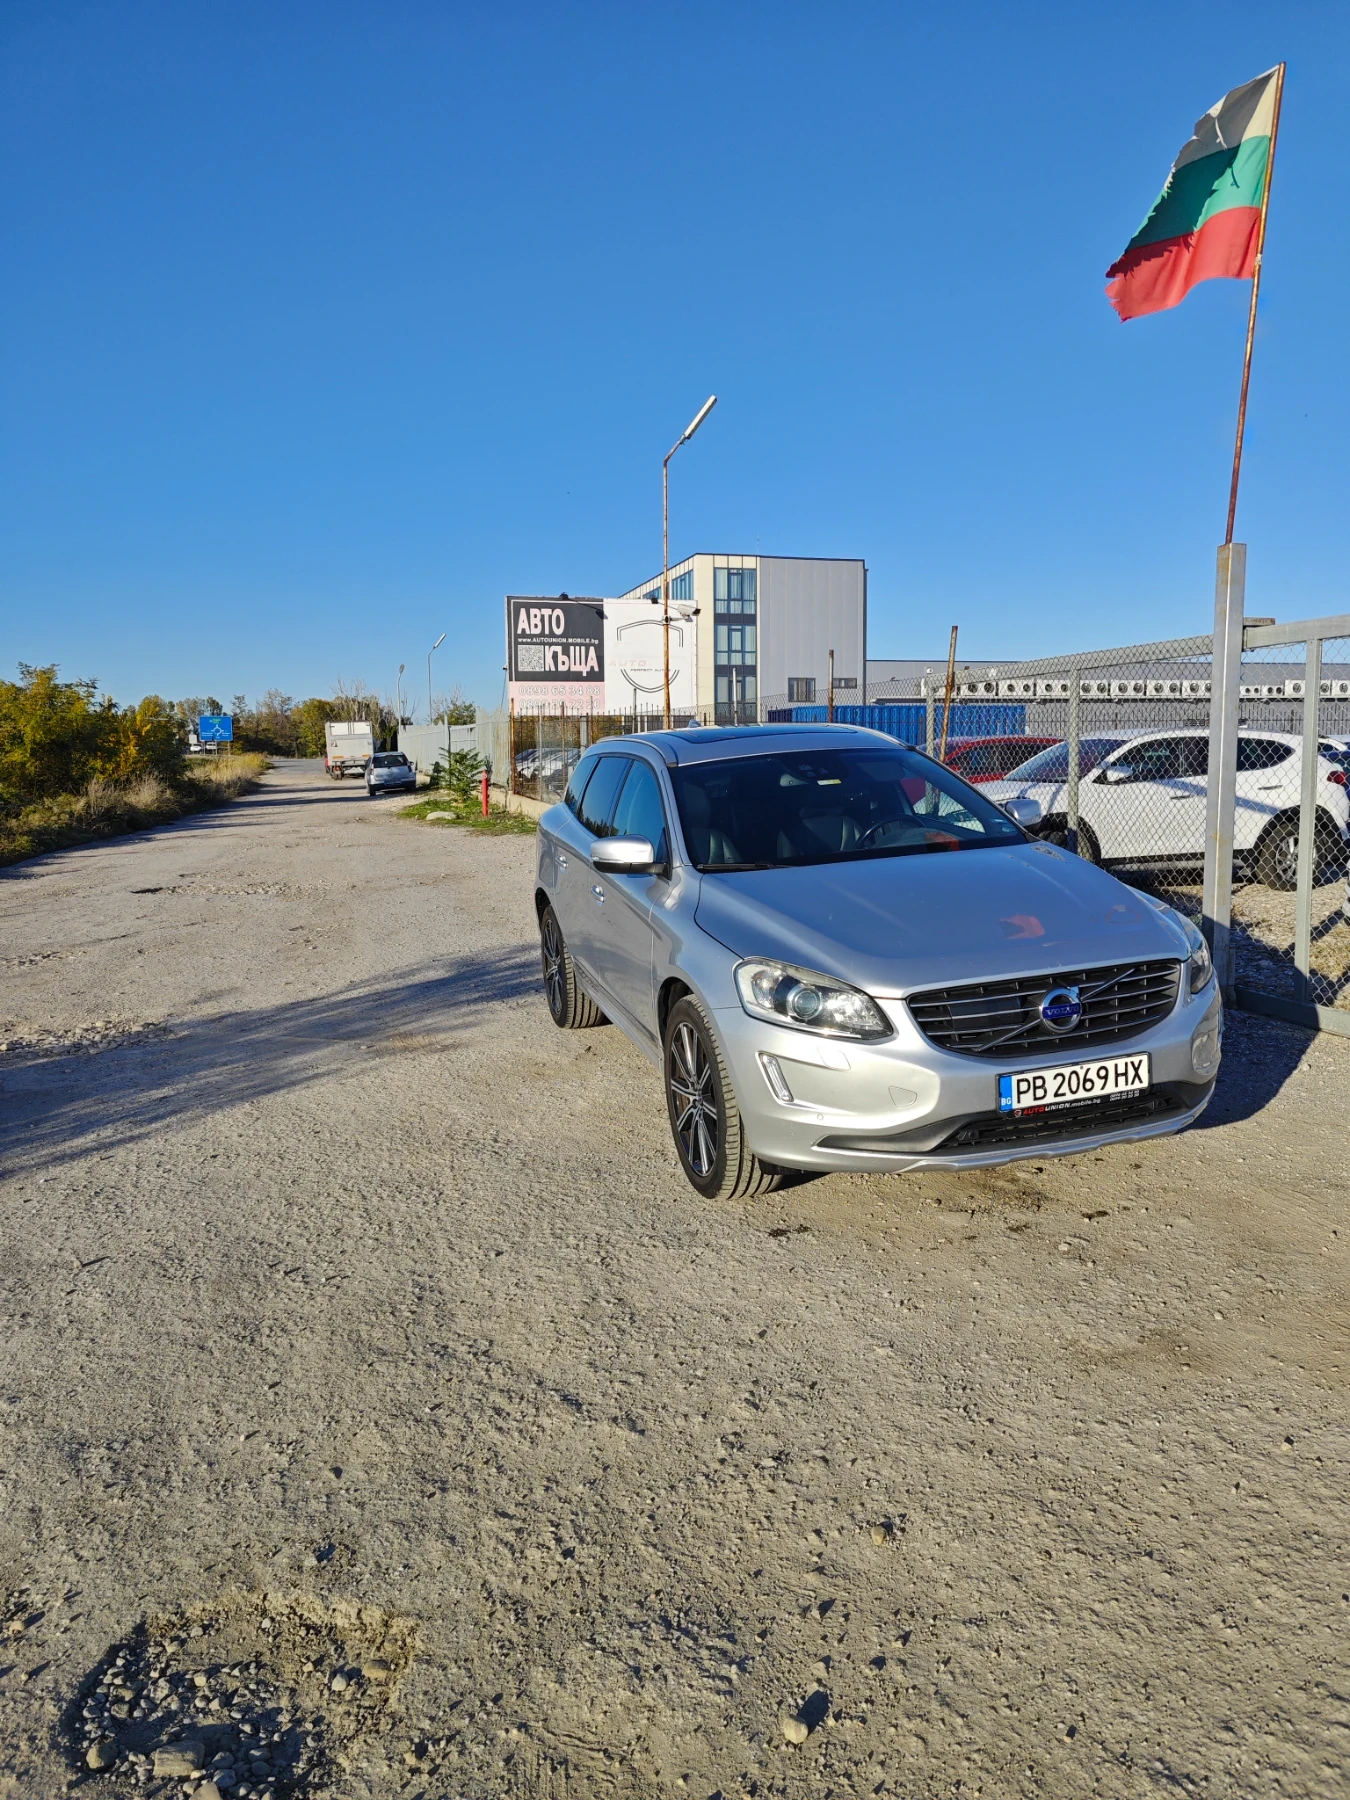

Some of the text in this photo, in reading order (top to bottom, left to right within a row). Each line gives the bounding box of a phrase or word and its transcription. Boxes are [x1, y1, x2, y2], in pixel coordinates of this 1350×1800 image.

[517, 607, 565, 635] АВТО
[544, 645, 599, 676] КЪЩА
[519, 685, 600, 696] 0898 65 34 88
[569, 699, 584, 710] 22
[1045, 1005, 1079, 1016] VOLVO
[1016, 1059, 1143, 1104] PB 2069 HX
[1001, 1097, 1012, 1106] BG
